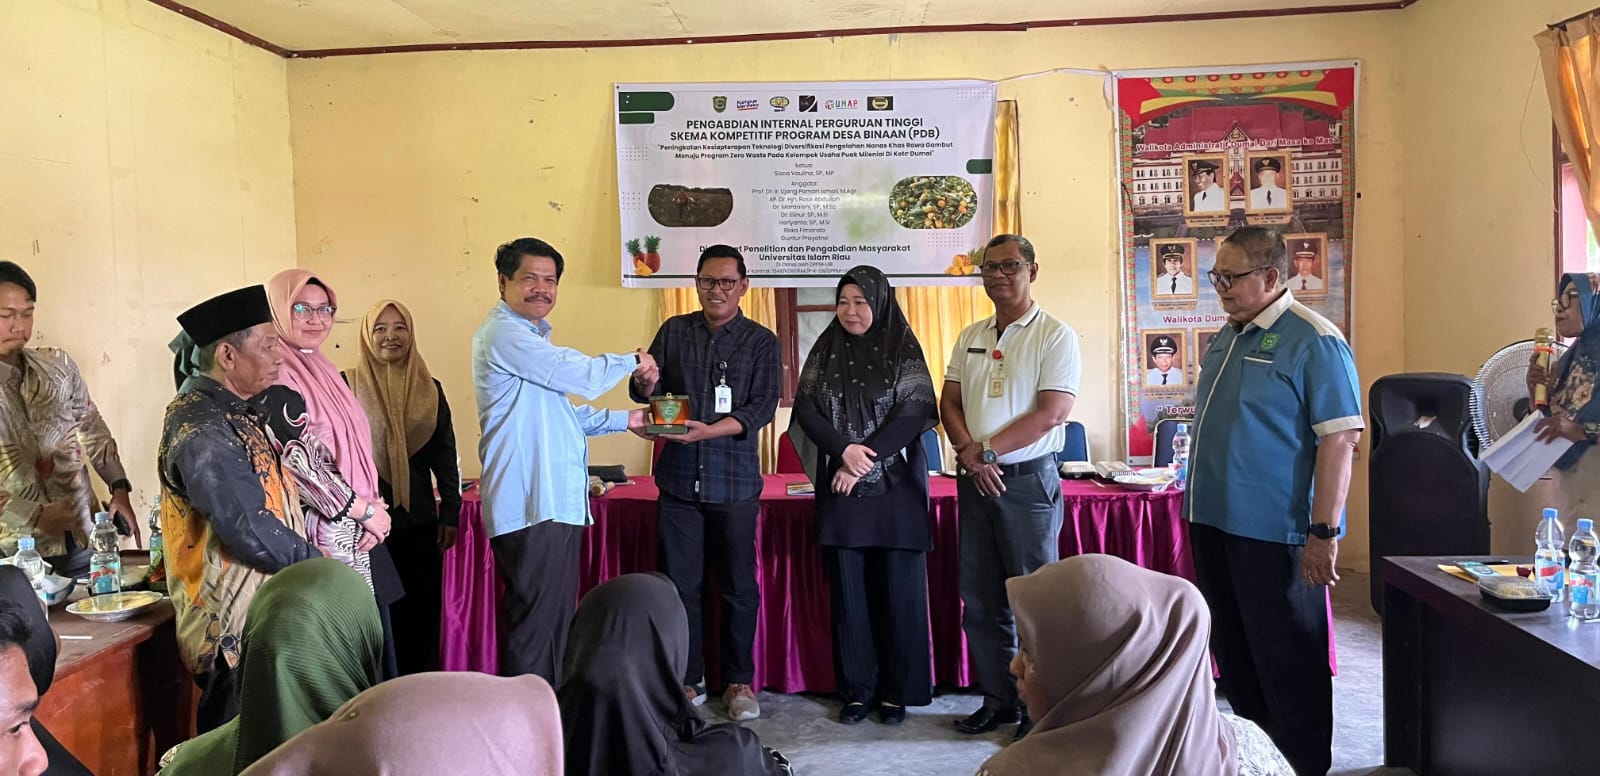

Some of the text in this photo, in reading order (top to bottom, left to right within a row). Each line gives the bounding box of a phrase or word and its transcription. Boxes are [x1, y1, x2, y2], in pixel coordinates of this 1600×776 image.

[687, 117, 923, 129] PENGABDIAN INTERNAL PERGURUAN TINGGI
[670, 126, 940, 141] SKEMA KOMPETITIF PROGRAM DESA BINAAN (PDB)
[752, 143, 784, 151] Teknologi
[1136, 143, 1173, 152] Walikota
[1174, 139, 1229, 150] Administratif
[1259, 137, 1278, 147] Dari
[1278, 137, 1302, 146] Masa
[1302, 136, 1314, 145] ke
[743, 244, 786, 253] Penelitian
[787, 244, 804, 253] dan
[806, 244, 857, 254] Pengabdian
[858, 244, 911, 254] Masyarakat
[759, 253, 850, 261] Universitas Islam Riau
[1163, 315, 1202, 323] Walikota
